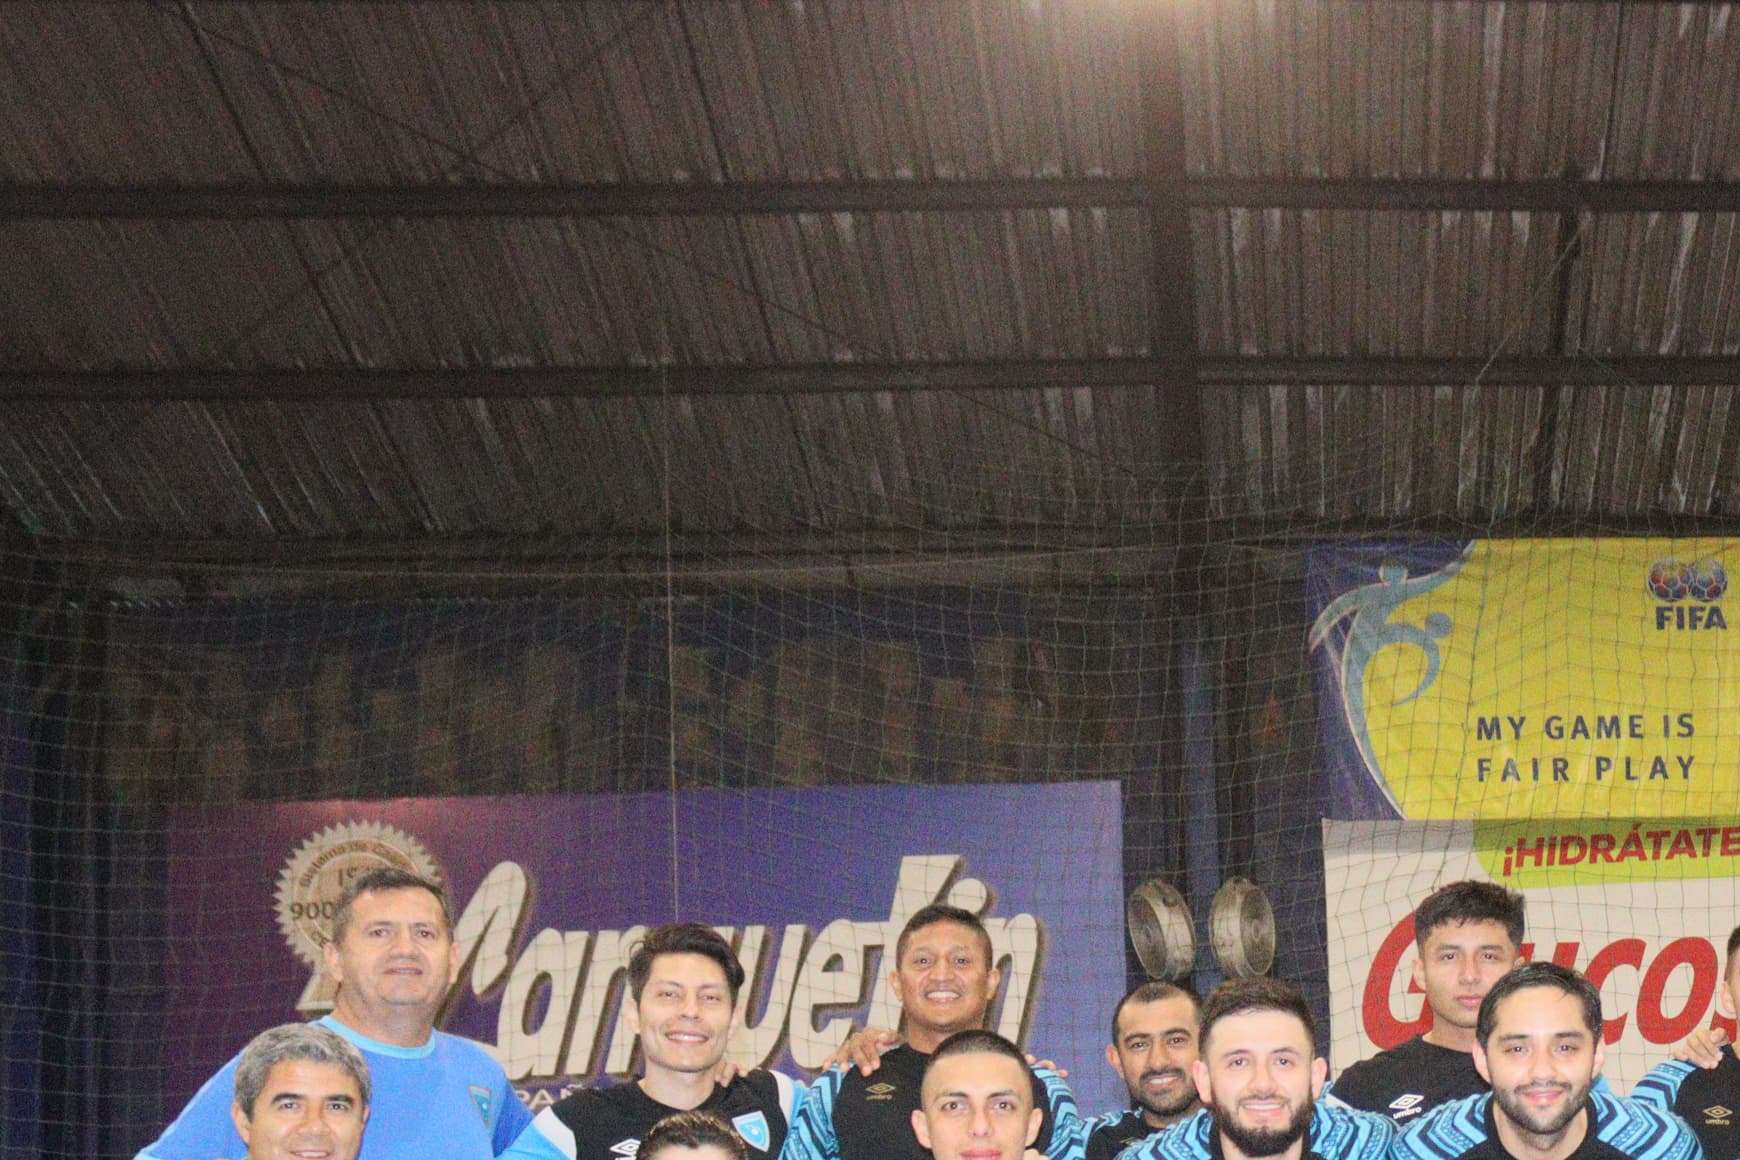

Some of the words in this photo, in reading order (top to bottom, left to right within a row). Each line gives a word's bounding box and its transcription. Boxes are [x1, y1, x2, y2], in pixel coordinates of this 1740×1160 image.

[1655, 605, 1727, 631] FIFA
[1476, 716, 1526, 741] MY
[1544, 714, 1644, 740] GAME
[1662, 713, 1695, 738] IS
[1477, 757, 1569, 783] FAIR
[1595, 755, 1694, 781] PLAY
[1393, 1106, 1422, 1120] umbro
